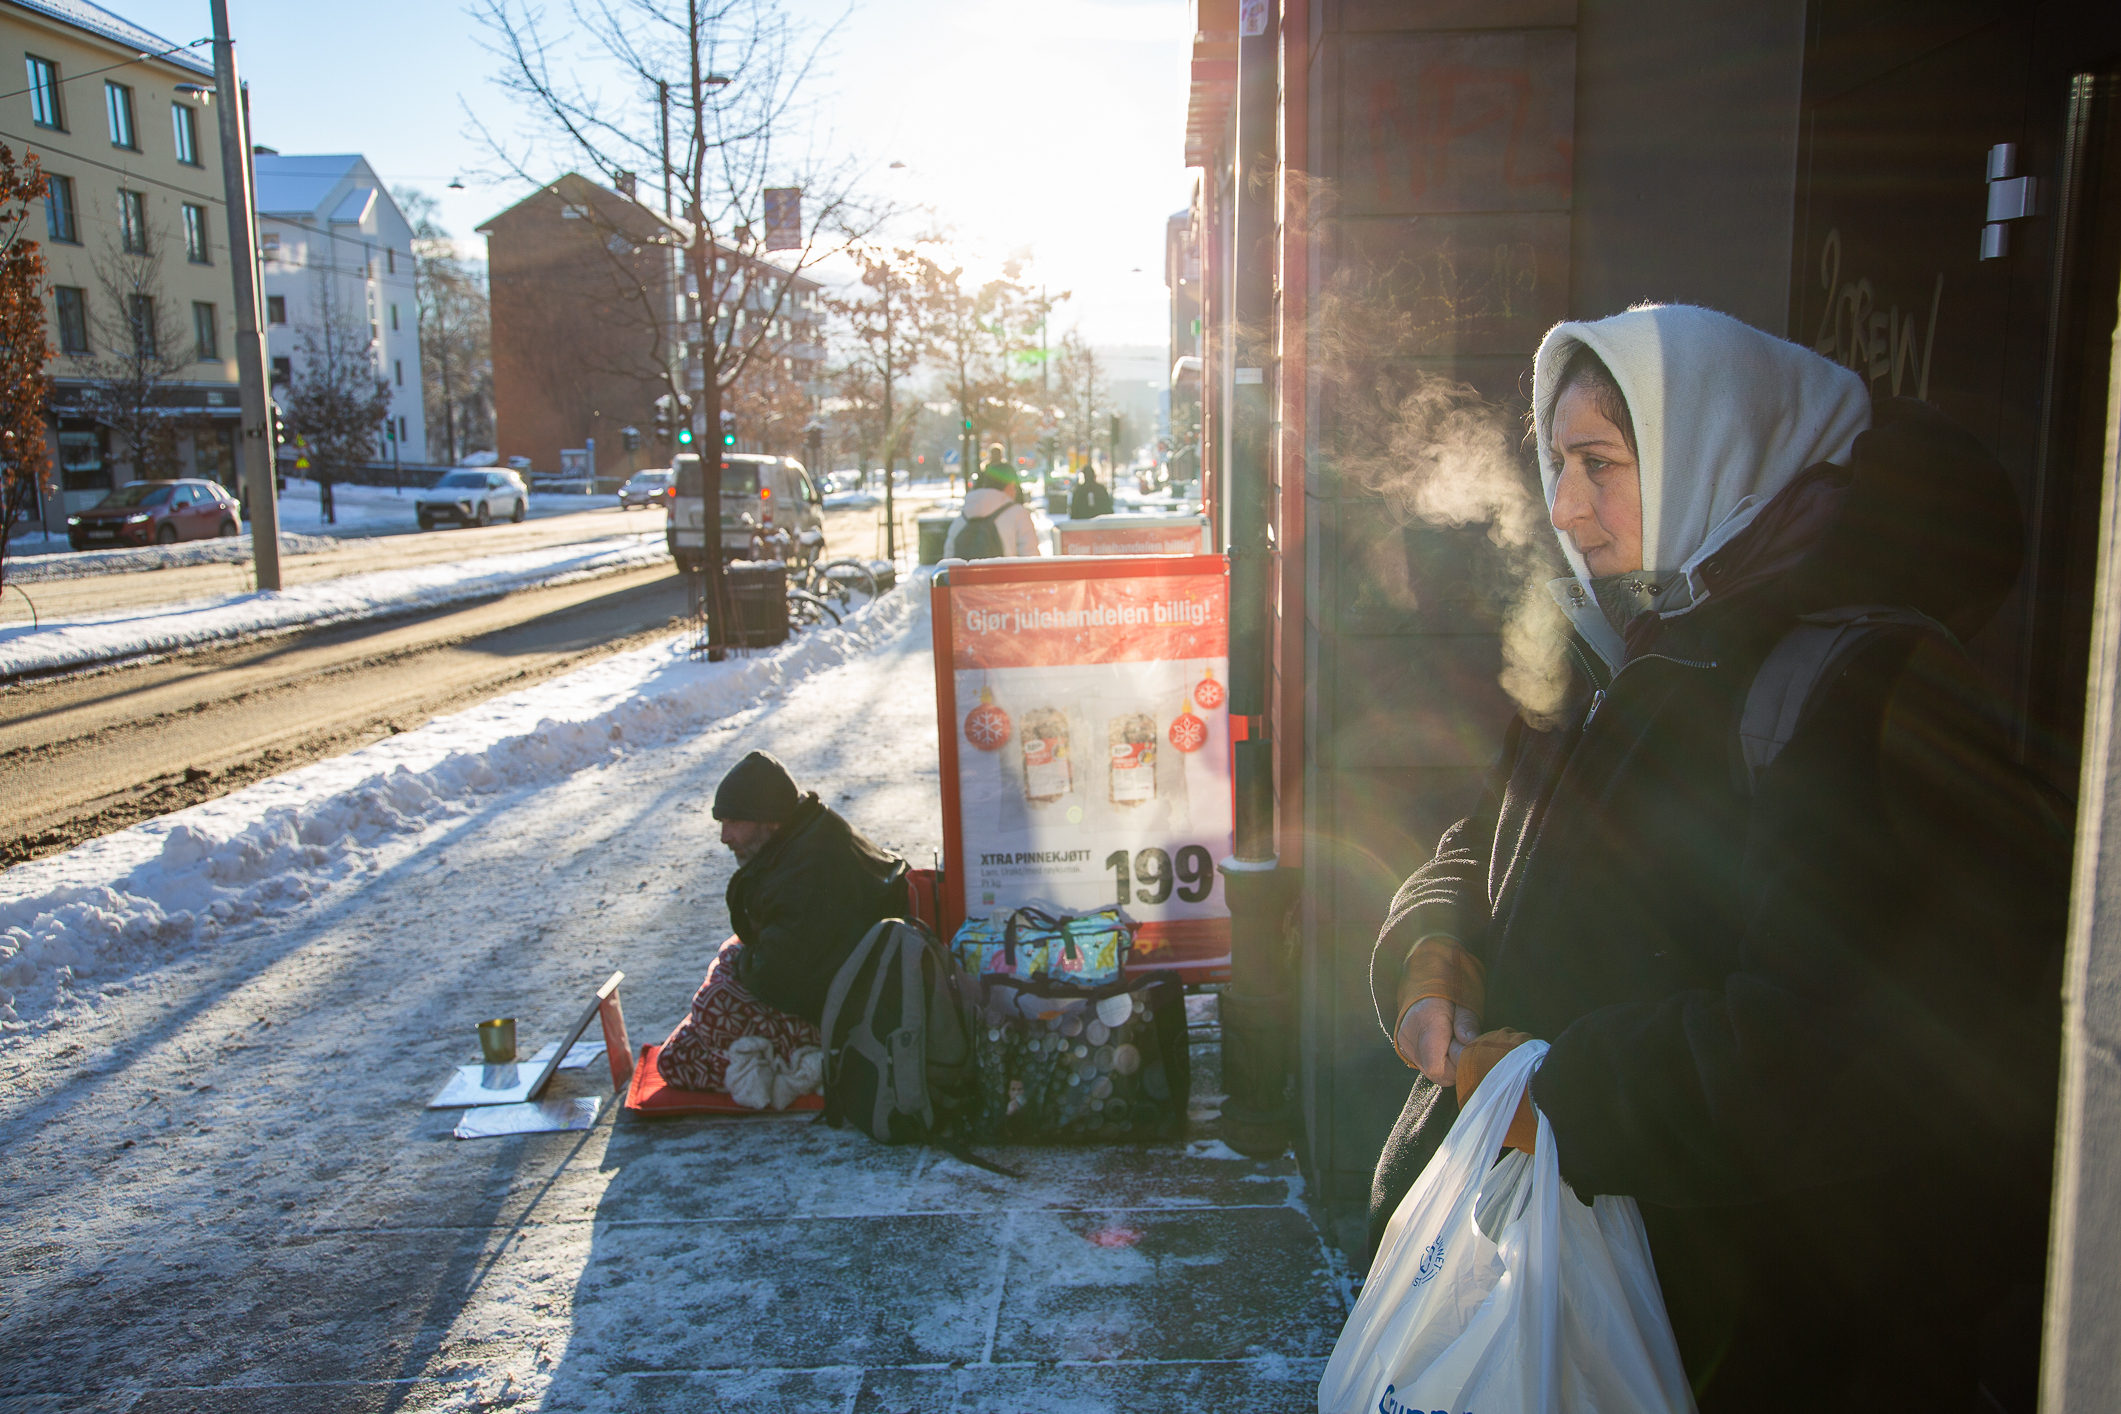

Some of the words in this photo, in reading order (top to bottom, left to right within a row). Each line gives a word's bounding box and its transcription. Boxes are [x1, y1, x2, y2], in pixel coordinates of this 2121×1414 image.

[966, 609, 1009, 635] Gjør
[1013, 604, 1149, 634] julehandelen
[1153, 599, 1211, 626] billig!
[981, 853, 1013, 866] XTRA
[1015, 850, 1091, 864] PINNEKJØTT
[1106, 845, 1214, 905] 199
